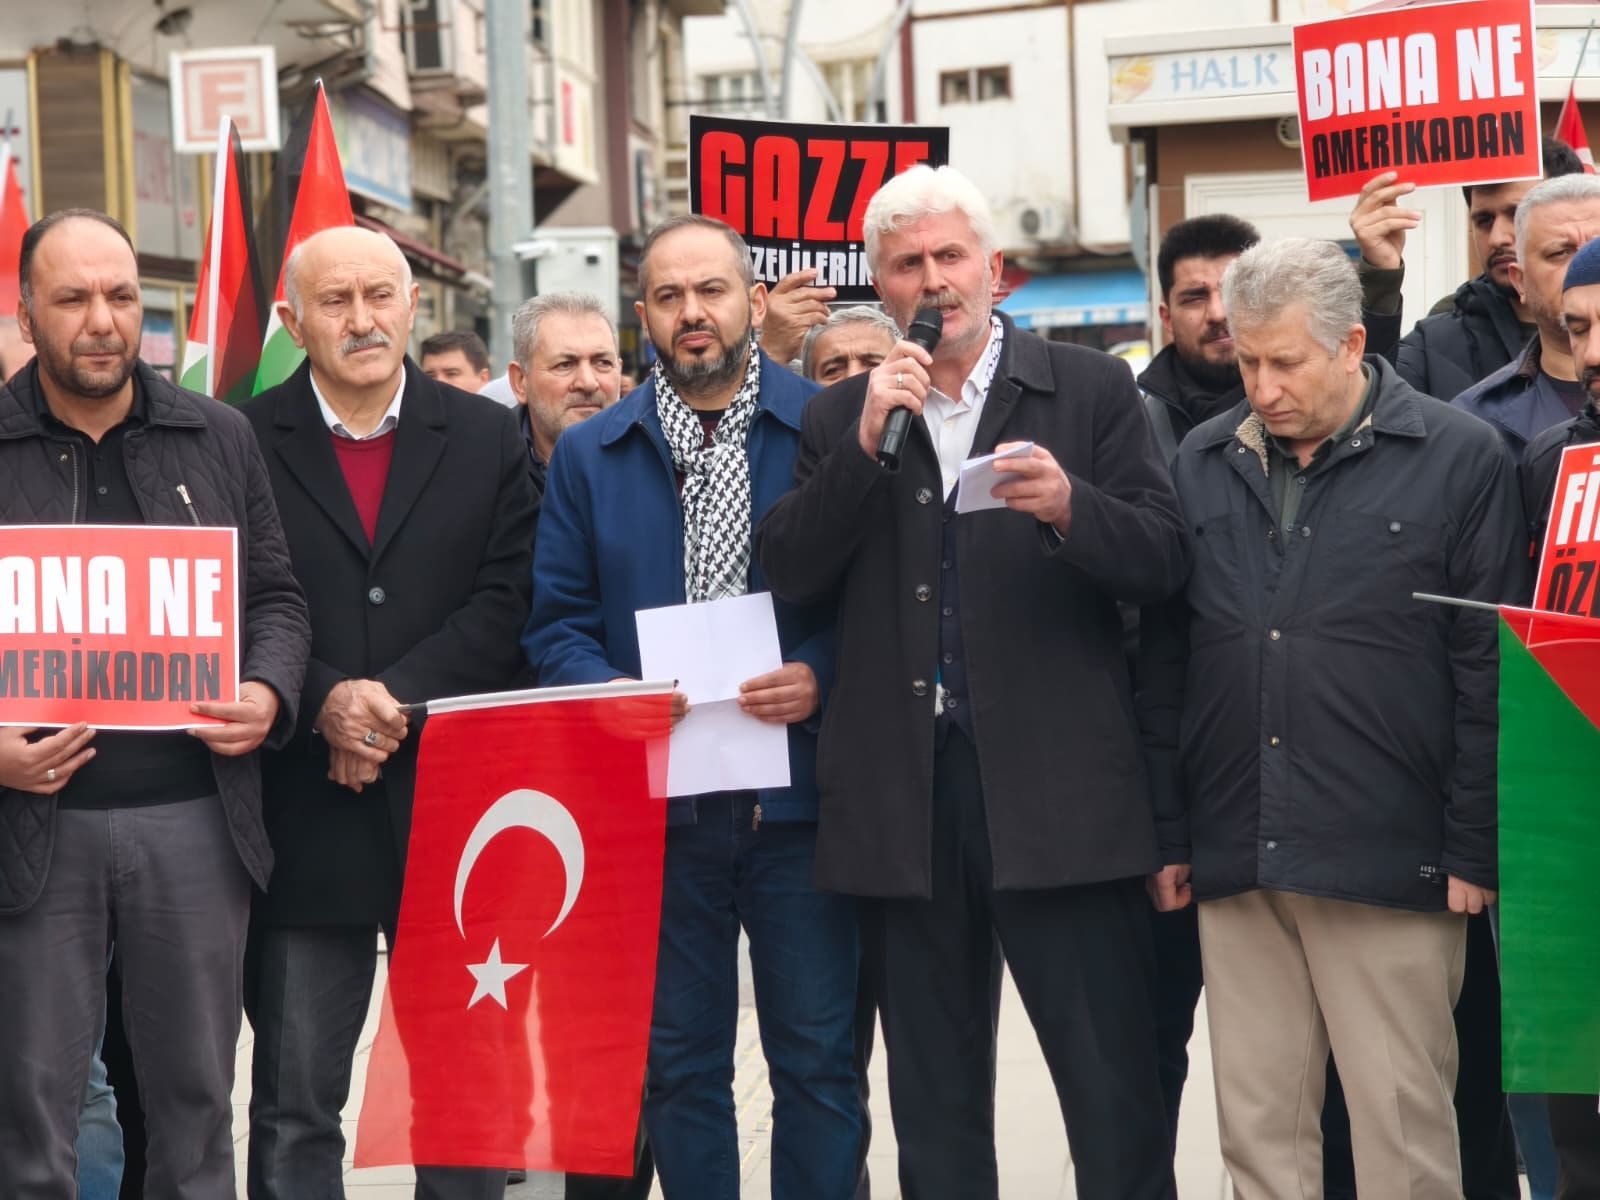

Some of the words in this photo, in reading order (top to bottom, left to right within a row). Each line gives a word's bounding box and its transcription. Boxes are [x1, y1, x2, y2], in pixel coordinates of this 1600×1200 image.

[1171, 53, 1279, 91] HALK
[1302, 32, 1439, 121] BANA
[1456, 24, 1524, 101] NE
[1312, 112, 1524, 179] AMERİKADAN
[1555, 455, 1600, 546] Fİ
[149, 557, 222, 637] NE
